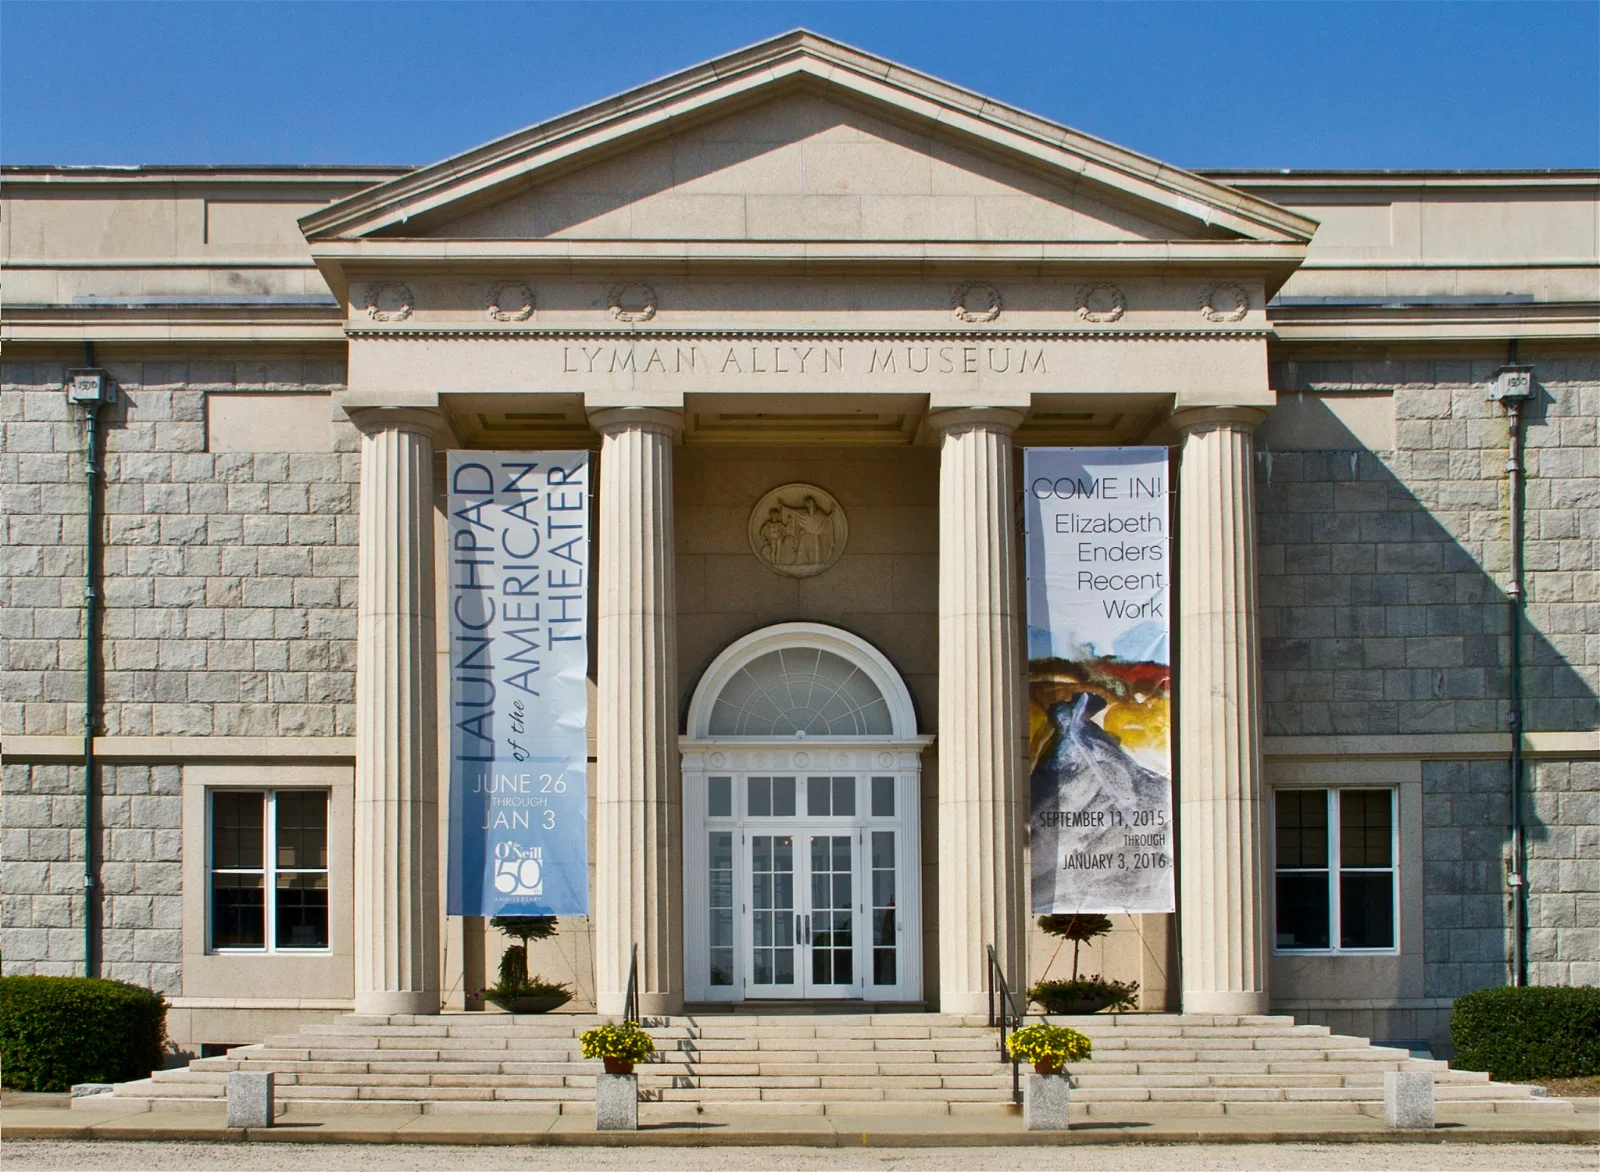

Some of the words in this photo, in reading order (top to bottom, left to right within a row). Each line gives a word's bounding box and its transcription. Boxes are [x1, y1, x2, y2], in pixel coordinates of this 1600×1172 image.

[563, 347, 698, 373] LYMAN
[720, 347, 844, 373] ALLYN
[867, 347, 1048, 373] MUSEUM
[1032, 477, 1118, 499] COME
[1129, 477, 1161, 498] IN!
[1055, 512, 1162, 533] Elizabeth
[547, 463, 583, 652] THEATER
[1078, 541, 1163, 561] Enders
[501, 463, 541, 697] AMERICAN
[1078, 571, 1163, 591] Recent
[453, 462, 496, 762] LAUNCHPAD
[1102, 597, 1163, 619] Work
[508, 699, 526, 734] the
[507, 738, 530, 762] of
[473, 774, 530, 794] JUNE
[540, 773, 567, 794] 26
[491, 796, 548, 807] THROUGH
[482, 810, 529, 830] JAN
[542, 809, 556, 830] 3
[1039, 811, 1104, 828] SEPTEMBER
[1109, 811, 1128, 829] 11,
[1133, 810, 1165, 827] 2015
[494, 840, 542, 860] O'Neill
[1123, 833, 1165, 847] THROUGH
[1062, 853, 1113, 870] JANUARY
[1118, 853, 1129, 872] 3,
[1134, 853, 1167, 870] 2016
[496, 859, 543, 896] 50
